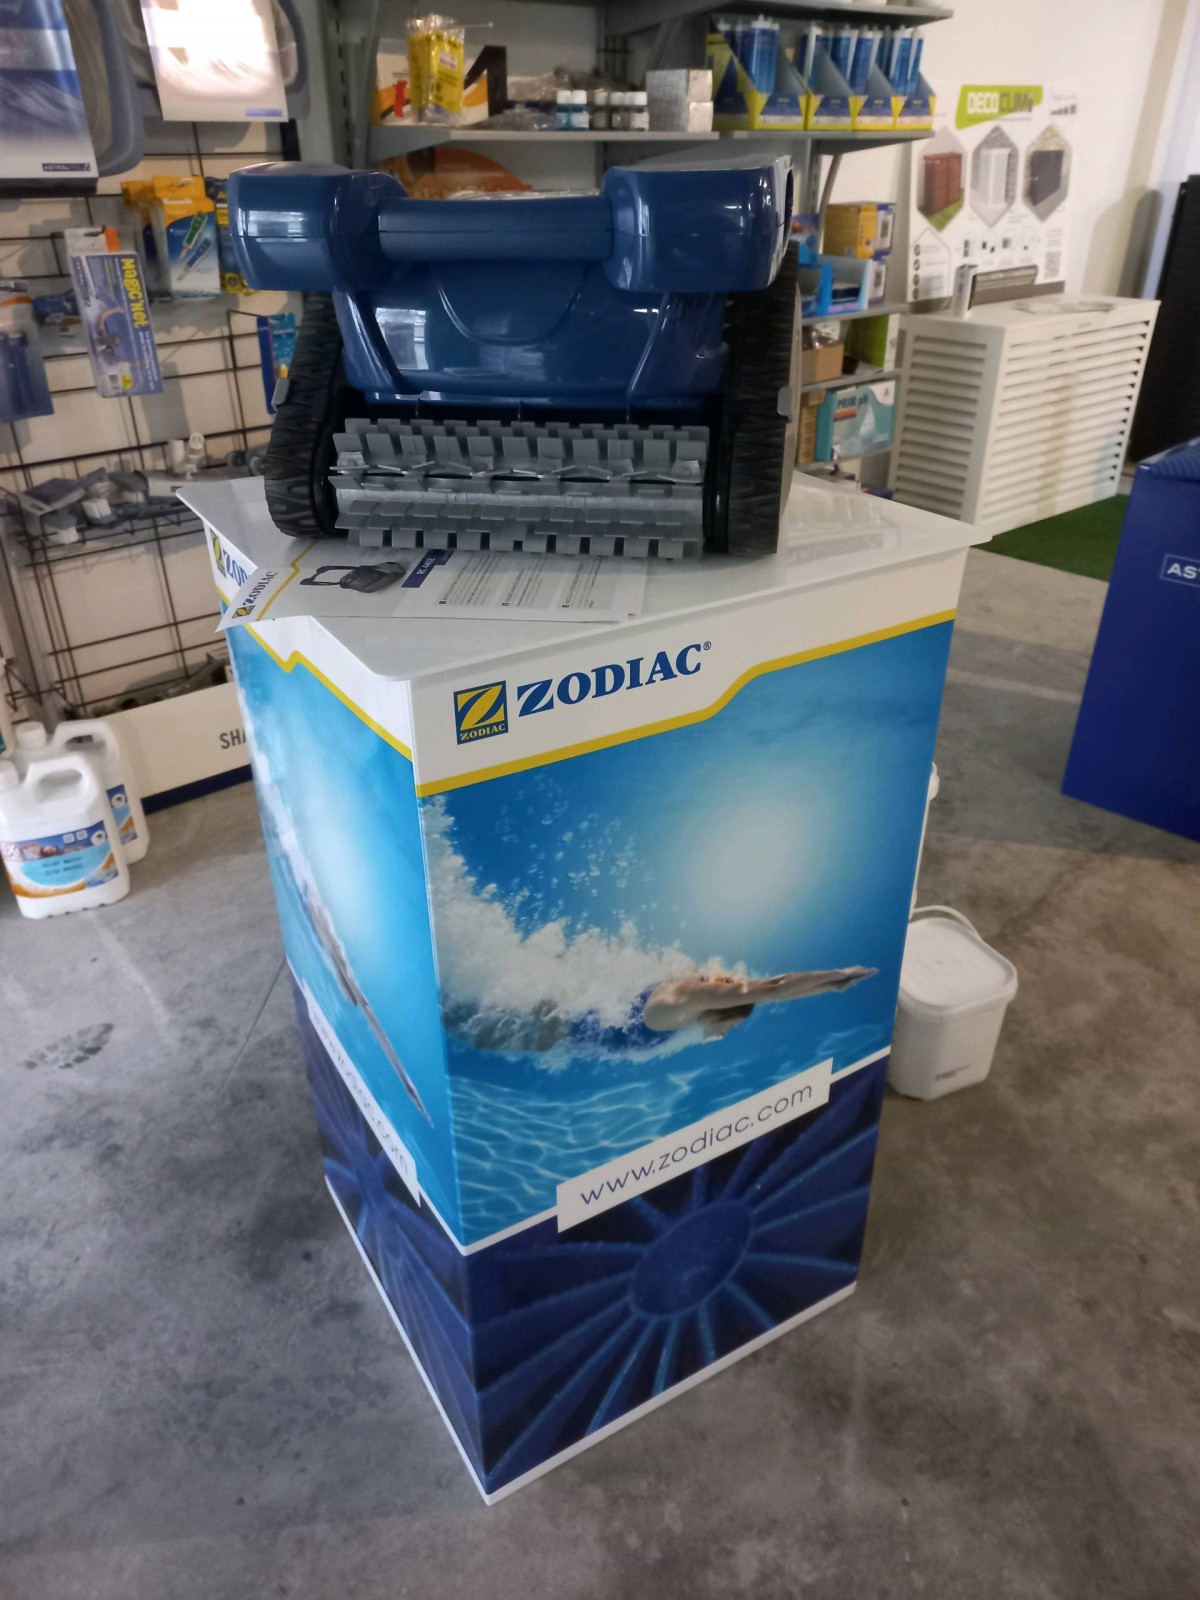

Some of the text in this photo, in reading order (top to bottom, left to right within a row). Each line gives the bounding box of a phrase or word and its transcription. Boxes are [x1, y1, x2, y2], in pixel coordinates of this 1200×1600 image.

[1167, 563, 1200, 579] AS
[242, 570, 279, 606] ZODIAC
[460, 722, 506, 742] ZODIAC
[579, 1084, 813, 1206] www.zodiac.com
